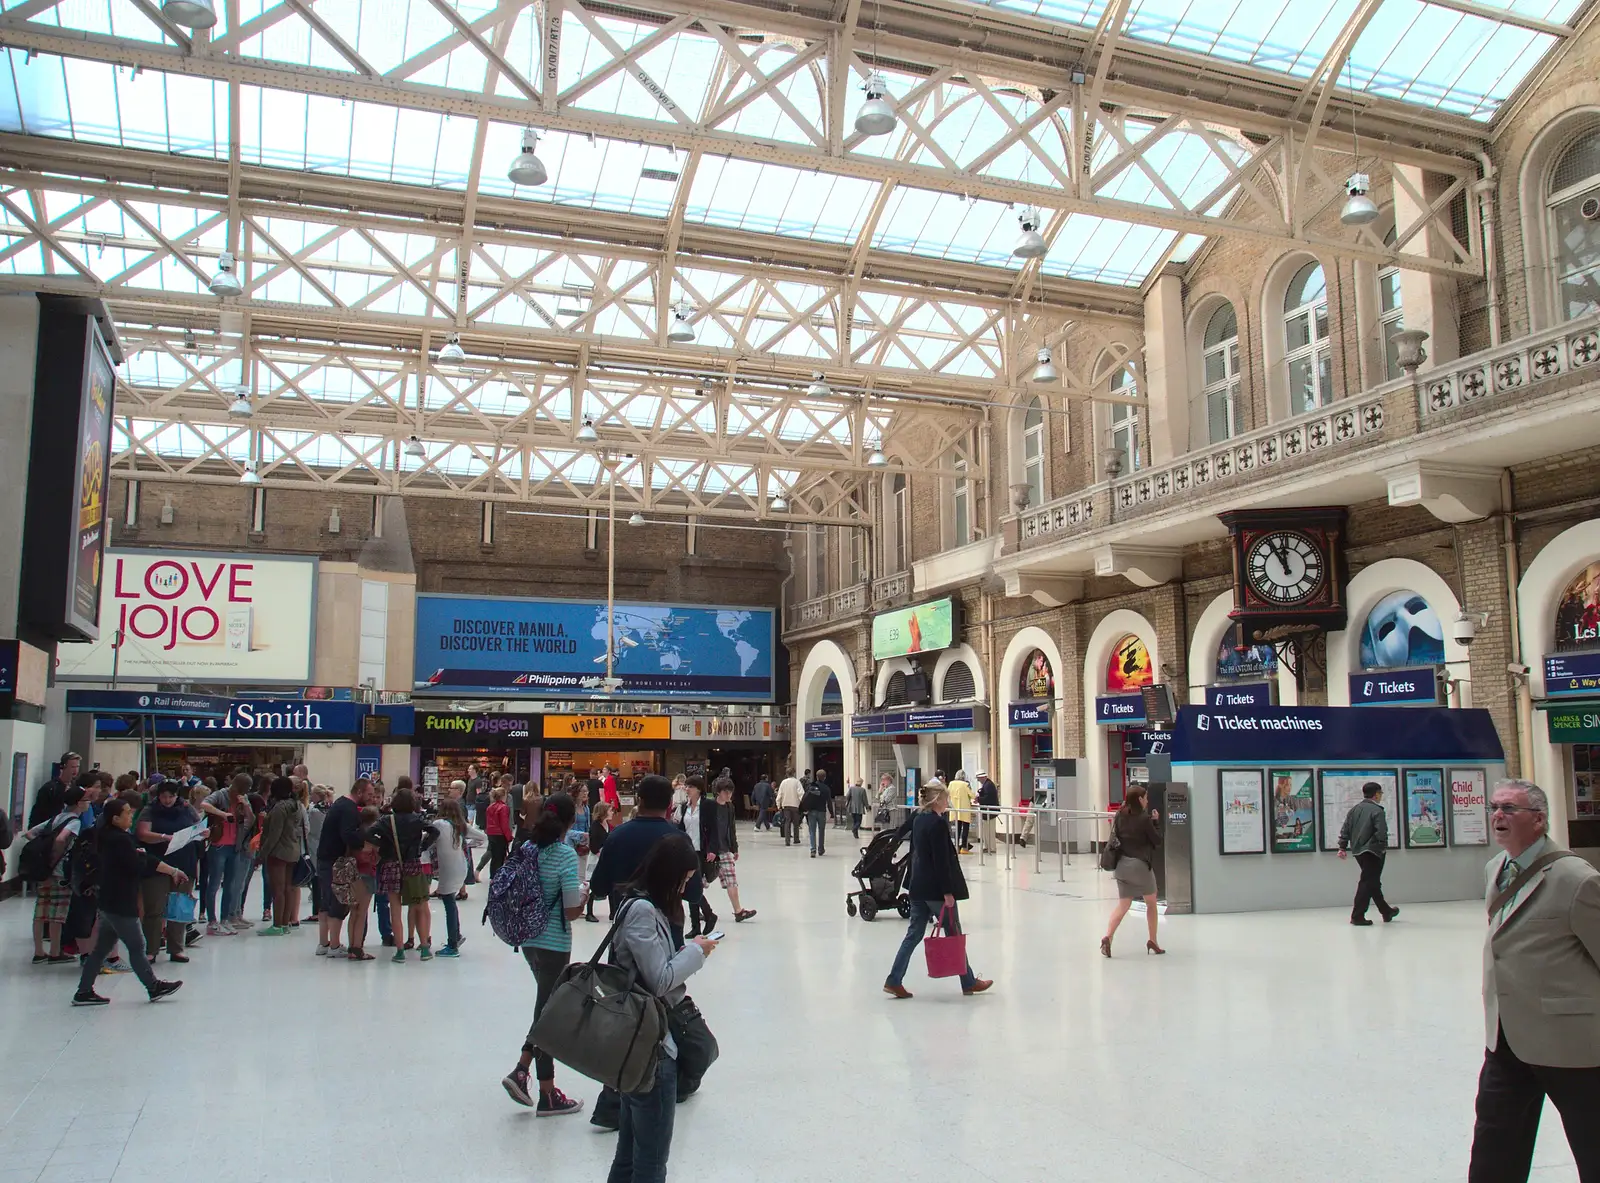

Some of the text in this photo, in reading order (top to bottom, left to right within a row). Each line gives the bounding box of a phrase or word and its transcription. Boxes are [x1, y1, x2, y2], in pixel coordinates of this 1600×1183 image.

[115, 558, 254, 603] LOVE
[111, 603, 220, 650] JOJO
[453, 619, 569, 638] DISCOVER MANILA.
[1573, 623, 1596, 640] Les
[440, 635, 577, 654] DISCOVER THE WORLD
[528, 674, 577, 685] Philippine
[1378, 681, 1415, 694] Tickets
[154, 697, 210, 708] Rail information
[1226, 694, 1254, 705] Tickets
[1021, 710, 1039, 719] Tickets
[1111, 704, 1134, 714] Tickets
[426, 715, 528, 734] funkypigeon
[571, 717, 645, 734] UPPER CRUST
[1214, 715, 1323, 730] Ticket machines
[1142, 732, 1172, 740] Tickets
[359, 762, 374, 772] WH
[1452, 781, 1473, 793] Child
[1452, 794, 1485, 808] Neglect
